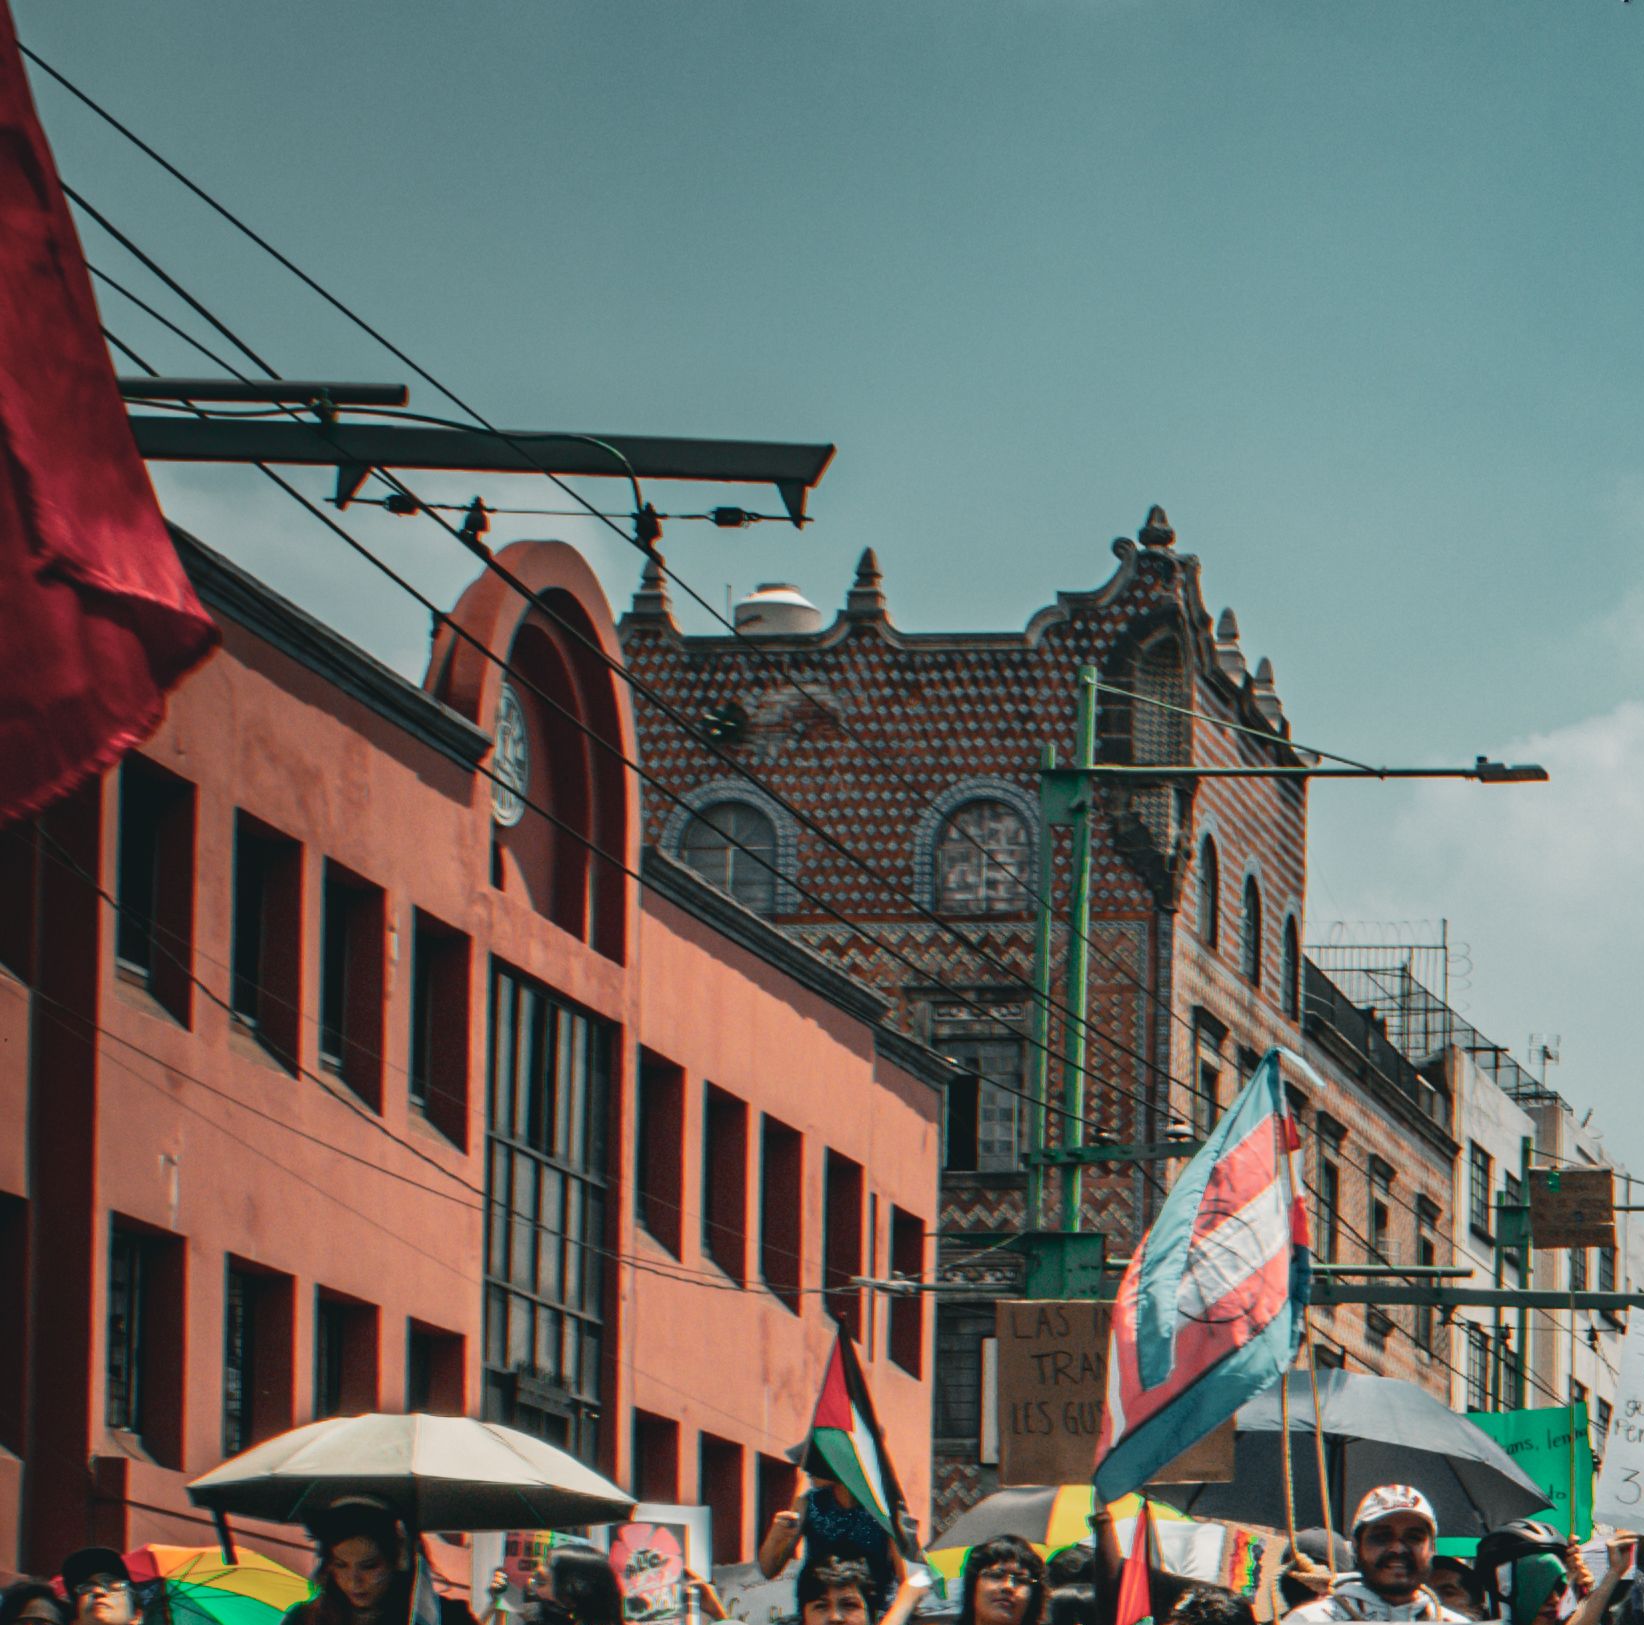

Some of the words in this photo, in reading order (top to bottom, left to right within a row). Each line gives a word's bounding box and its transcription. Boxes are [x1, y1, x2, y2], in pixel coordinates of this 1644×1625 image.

[1012, 1307, 1071, 1340] LAS
[1030, 1349, 1108, 1387] TRAN
[1011, 1400, 1052, 1436] LES
[1615, 1465, 1643, 1506] 3
